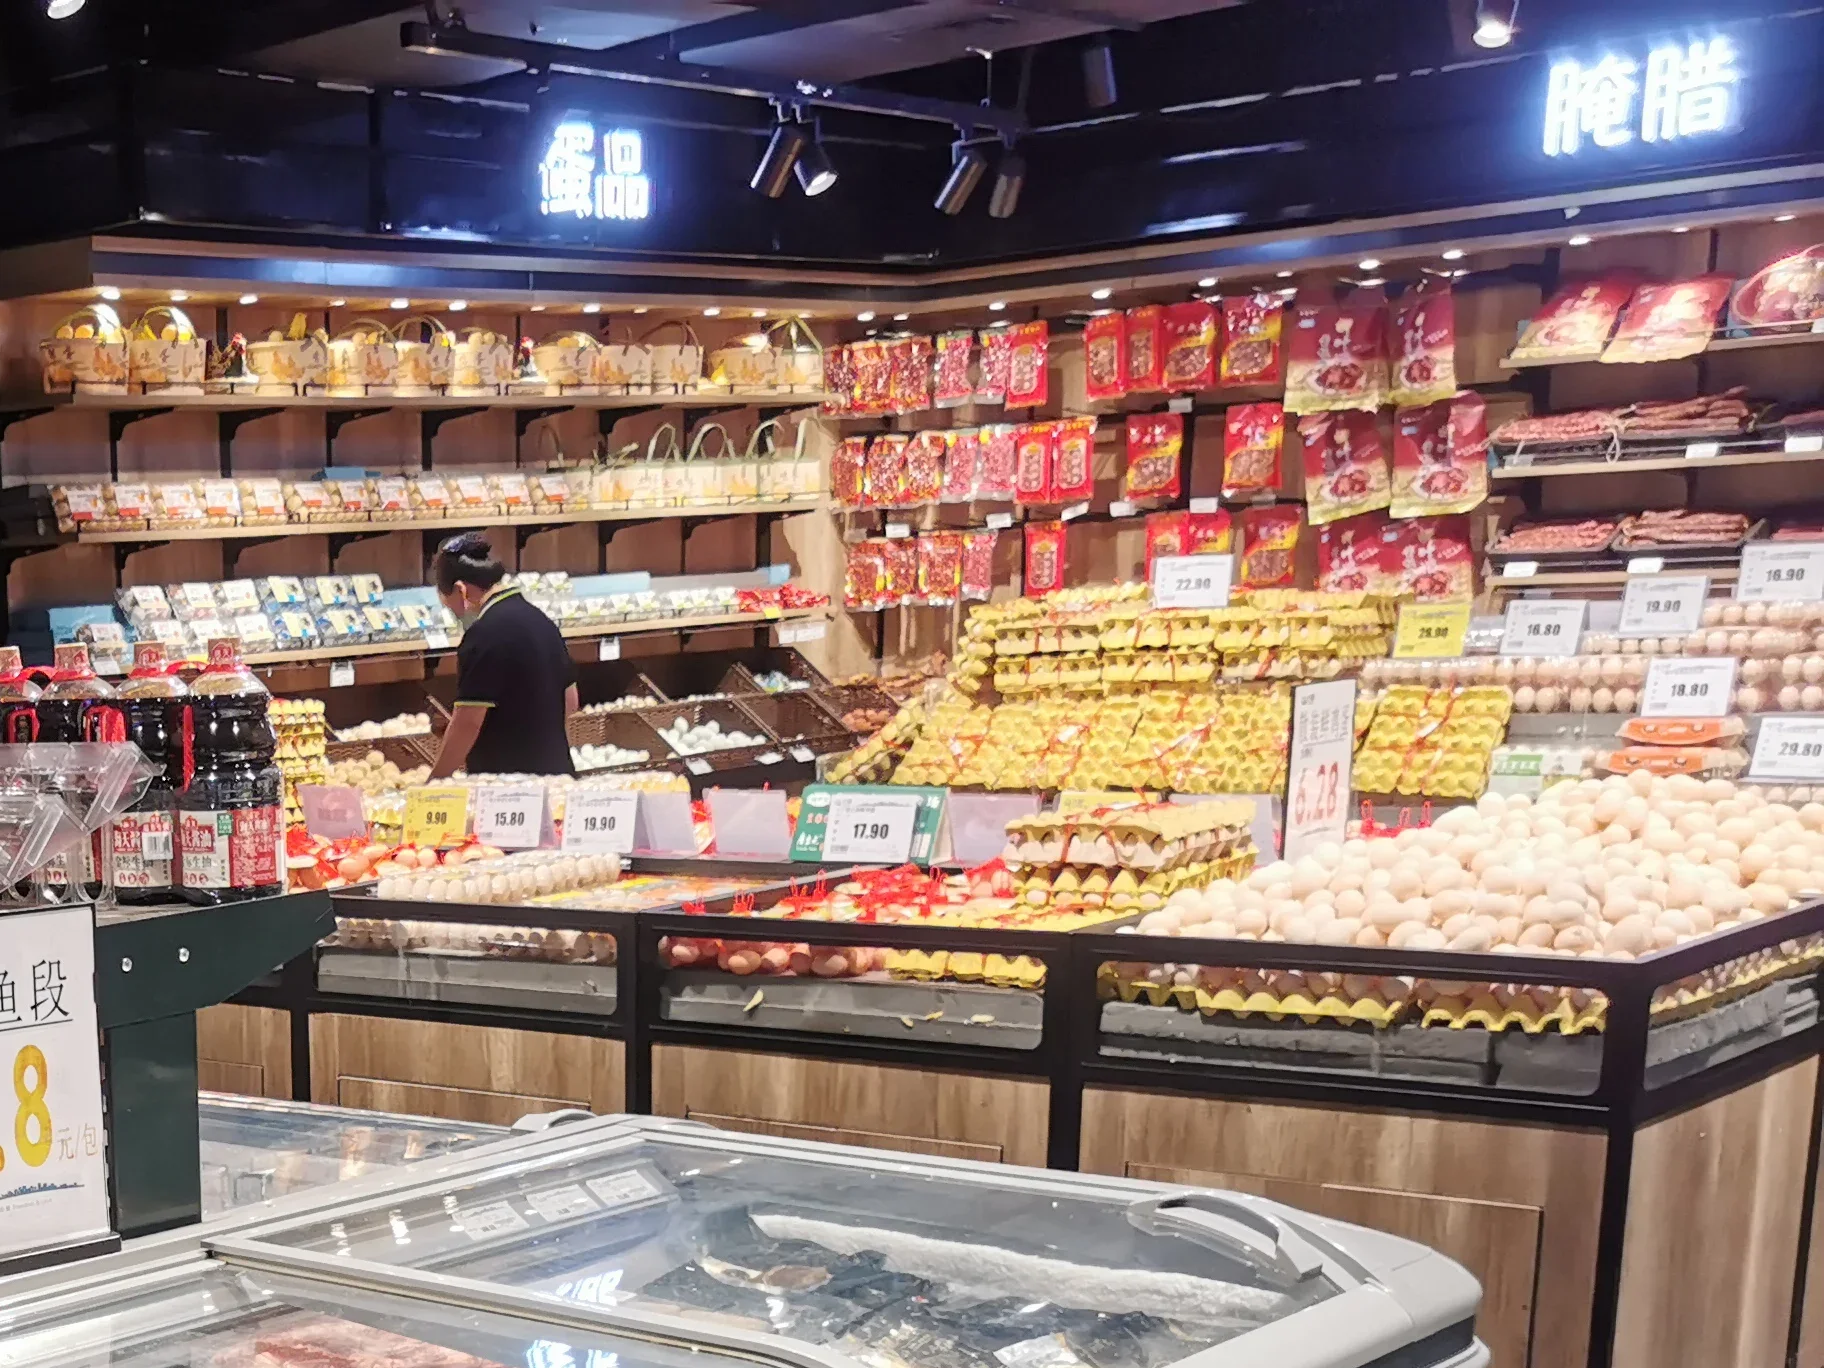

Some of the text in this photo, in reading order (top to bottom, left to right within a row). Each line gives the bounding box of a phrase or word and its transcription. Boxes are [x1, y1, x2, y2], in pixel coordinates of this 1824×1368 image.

[1542, 36, 1738, 157] 腌腊
[495, 812, 525, 826] 15.80
[584, 816, 616, 831] 19.90
[854, 824, 889, 839] 17.90
